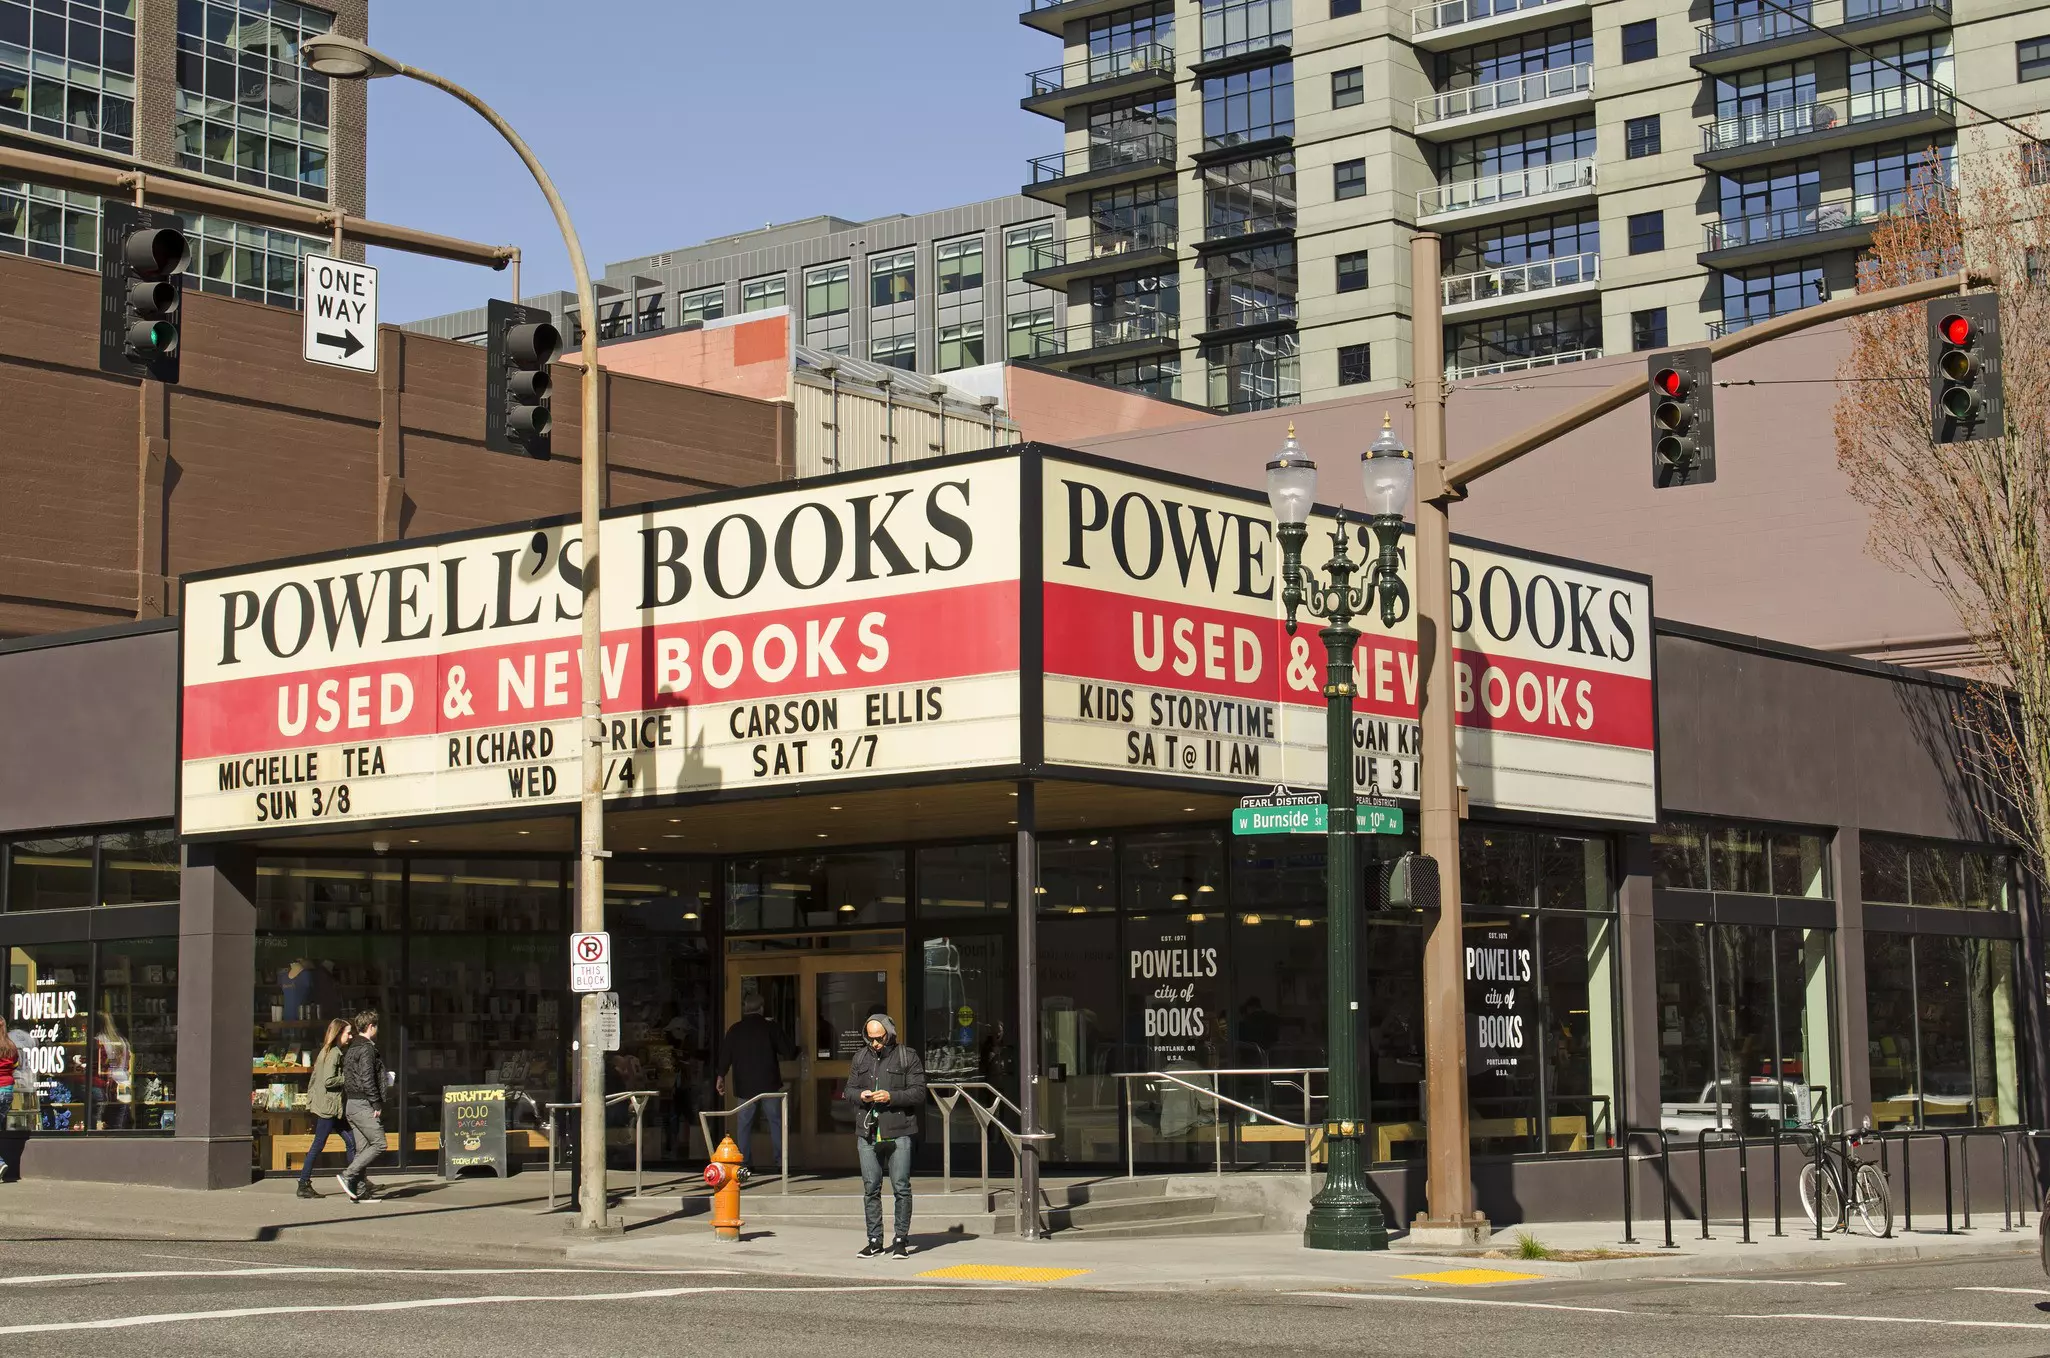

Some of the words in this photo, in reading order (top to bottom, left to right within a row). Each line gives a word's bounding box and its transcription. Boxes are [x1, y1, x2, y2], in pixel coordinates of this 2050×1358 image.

[319, 266, 365, 297] ONE
[317, 294, 367, 325] WAY
[217, 532, 583, 666] POWELL'S
[636, 478, 974, 610] BOOKS
[1449, 557, 1635, 663] BOOKS
[277, 671, 415, 737] USED
[443, 664, 475, 721] &
[498, 642, 630, 713] NEW
[656, 611, 890, 694] BOOKS
[1132, 610, 1263, 684] USED
[1286, 635, 1321, 693] &
[1454, 661, 1594, 731] BOOKS
[729, 697, 838, 741] CARSON
[865, 686, 943, 727] ELLIS
[1079, 683, 1134, 724] KIDS
[1150, 691, 1275, 739] STORYTIME
[448, 727, 554, 768] RICHARD
[1353, 717, 1389, 752] GAN
[218, 752, 318, 792] MICHELLE
[342, 745, 386, 779] TEA
[752, 740, 808, 778] SAT
[830, 734, 878, 771] 3/7
[1355, 755, 1378, 787] UE
[507, 764, 557, 799] WED
[602, 756, 636, 791] /4
[256, 790, 297, 823] SUN
[311, 784, 351, 817] 3/8
[1243, 798, 1273, 808] PEARL
[1276, 796, 1319, 806] DISTRICT
[1355, 796, 1373, 806] PEARL
[1373, 798, 1396, 808] DISTRICT
[1239, 818, 1248, 829] W
[1253, 810, 1309, 829] Burnside
[1356, 815, 1366, 826] NW
[1370, 811, 1385, 828] 10th
[1389, 817, 1397, 829] Av
[580, 965, 601, 976] THIS
[1130, 947, 1218, 979] POWELL'S
[1465, 947, 1531, 982] POWELL'S
[576, 975, 605, 987] BLOCK
[1154, 984, 1178, 1003] city
[1180, 982, 1194, 1002] of
[13, 990, 77, 1021] POWELL'S
[1485, 988, 1503, 1009] city
[1504, 988, 1515, 1009] of
[29, 1024, 47, 1042] city
[48, 1023, 59, 1042] of
[1144, 1007, 1205, 1037] BOOKS
[1478, 1014, 1524, 1049] BOOKS
[444, 1089, 506, 1103] STORYTIME
[457, 1105, 489, 1120] DOJO
[457, 1119, 488, 1128] DAYCARE
